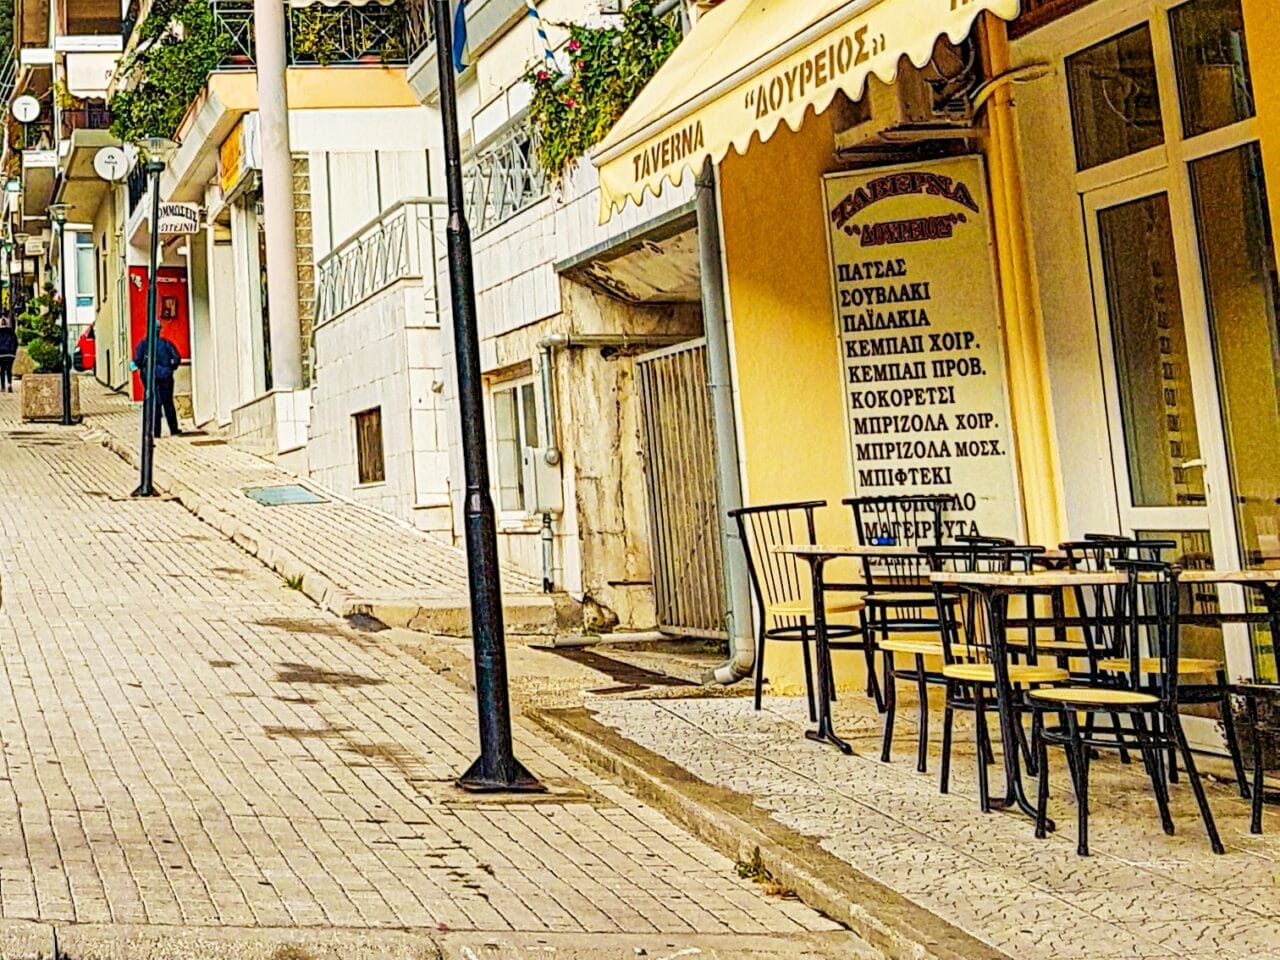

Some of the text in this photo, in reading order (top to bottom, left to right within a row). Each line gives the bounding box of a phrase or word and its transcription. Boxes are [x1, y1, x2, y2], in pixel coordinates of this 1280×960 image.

[632, 120, 705, 183] TAVERNA
[831, 172, 979, 229] ΤΑΒΕΡΝΑ
[158, 205, 197, 222] ΟΜΜΩΣΕΙΣ
[158, 223, 197, 232] ΩΤΕΙΝΗ
[838, 259, 907, 282] ΠΑΤΣΑΣ
[840, 282, 931, 307] ΣΟΥΒΛΑΚΙ
[843, 309, 931, 333] ΠΑΪΔΑΚΙΑ
[846, 331, 980, 358] ΚΕΜΠΑΠ ΧΟΙΡ.
[848, 358, 986, 383] ΚΕΜΠΑΠ ΠΡΟΒ.
[851, 386, 955, 409] ΚΟΚΟΡΕΤΣΙ
[853, 412, 999, 435] ΜΠΡΙΖΟΛΑ ΧΟΙΡ.
[856, 440, 1006, 461] ΜΠΡΙΖΟΛΑ ΜΟΣΧ.
[859, 466, 952, 487] ΜΠΙΦΤΕΚΙ
